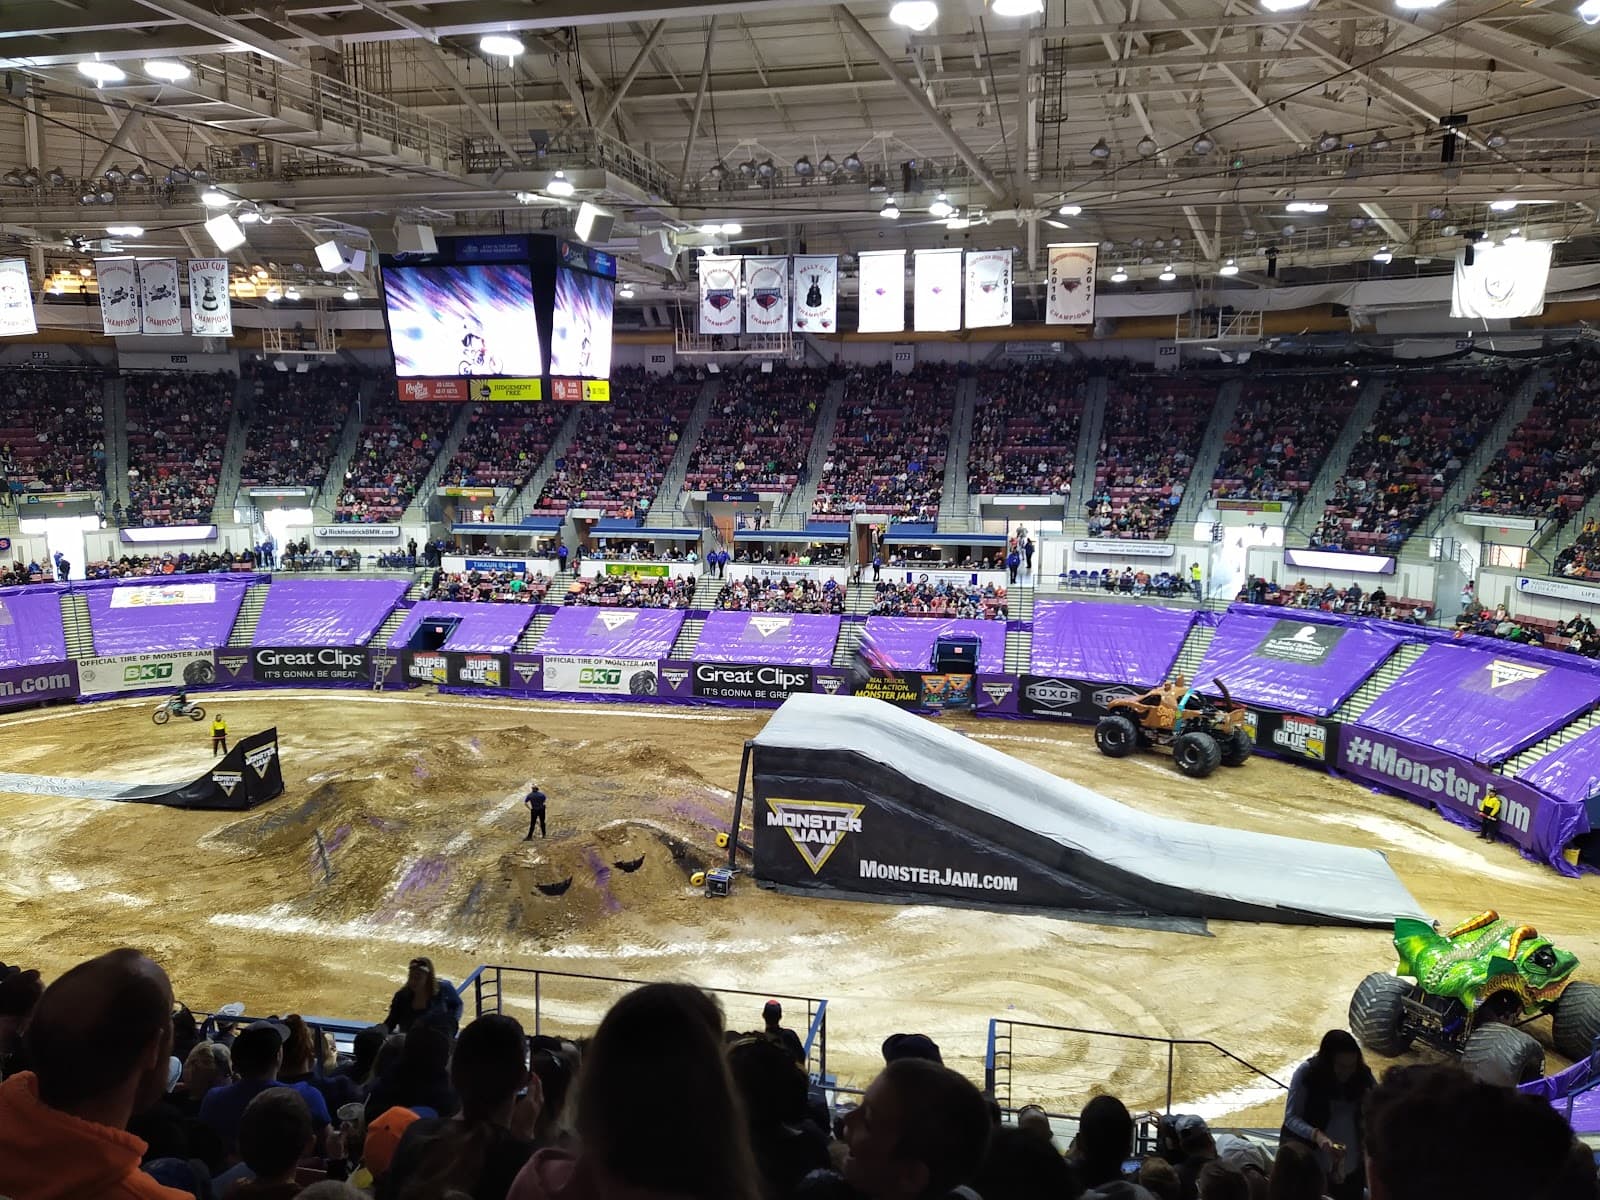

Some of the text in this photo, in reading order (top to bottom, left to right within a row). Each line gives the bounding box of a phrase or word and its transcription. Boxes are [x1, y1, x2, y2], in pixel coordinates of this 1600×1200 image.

[191, 261, 225, 272] KELLY CUP
[800, 265, 832, 274] KELLY CUP
[80, 657, 116, 667] OFFICIAL
[120, 655, 137, 663] TIRE
[153, 651, 192, 660] MONSTER
[256, 649, 362, 669] Great Clips
[416, 658, 446, 668] SUPER
[468, 660, 498, 670] SUPER
[124, 662, 173, 682] BKT
[410, 666, 432, 677] GLUE
[461, 669, 485, 680] GLUE
[579, 668, 622, 685] BKT
[697, 666, 805, 690] Great Clips
[721, 689, 752, 697] GONNA
[855, 690, 917, 701] MONSTER JAM!
[1028, 688, 1078, 700] ROXOR
[1284, 721, 1325, 740] SUPER
[1276, 730, 1306, 748] GLUE
[767, 812, 862, 832] MONSTER
[792, 829, 837, 845] JAM
